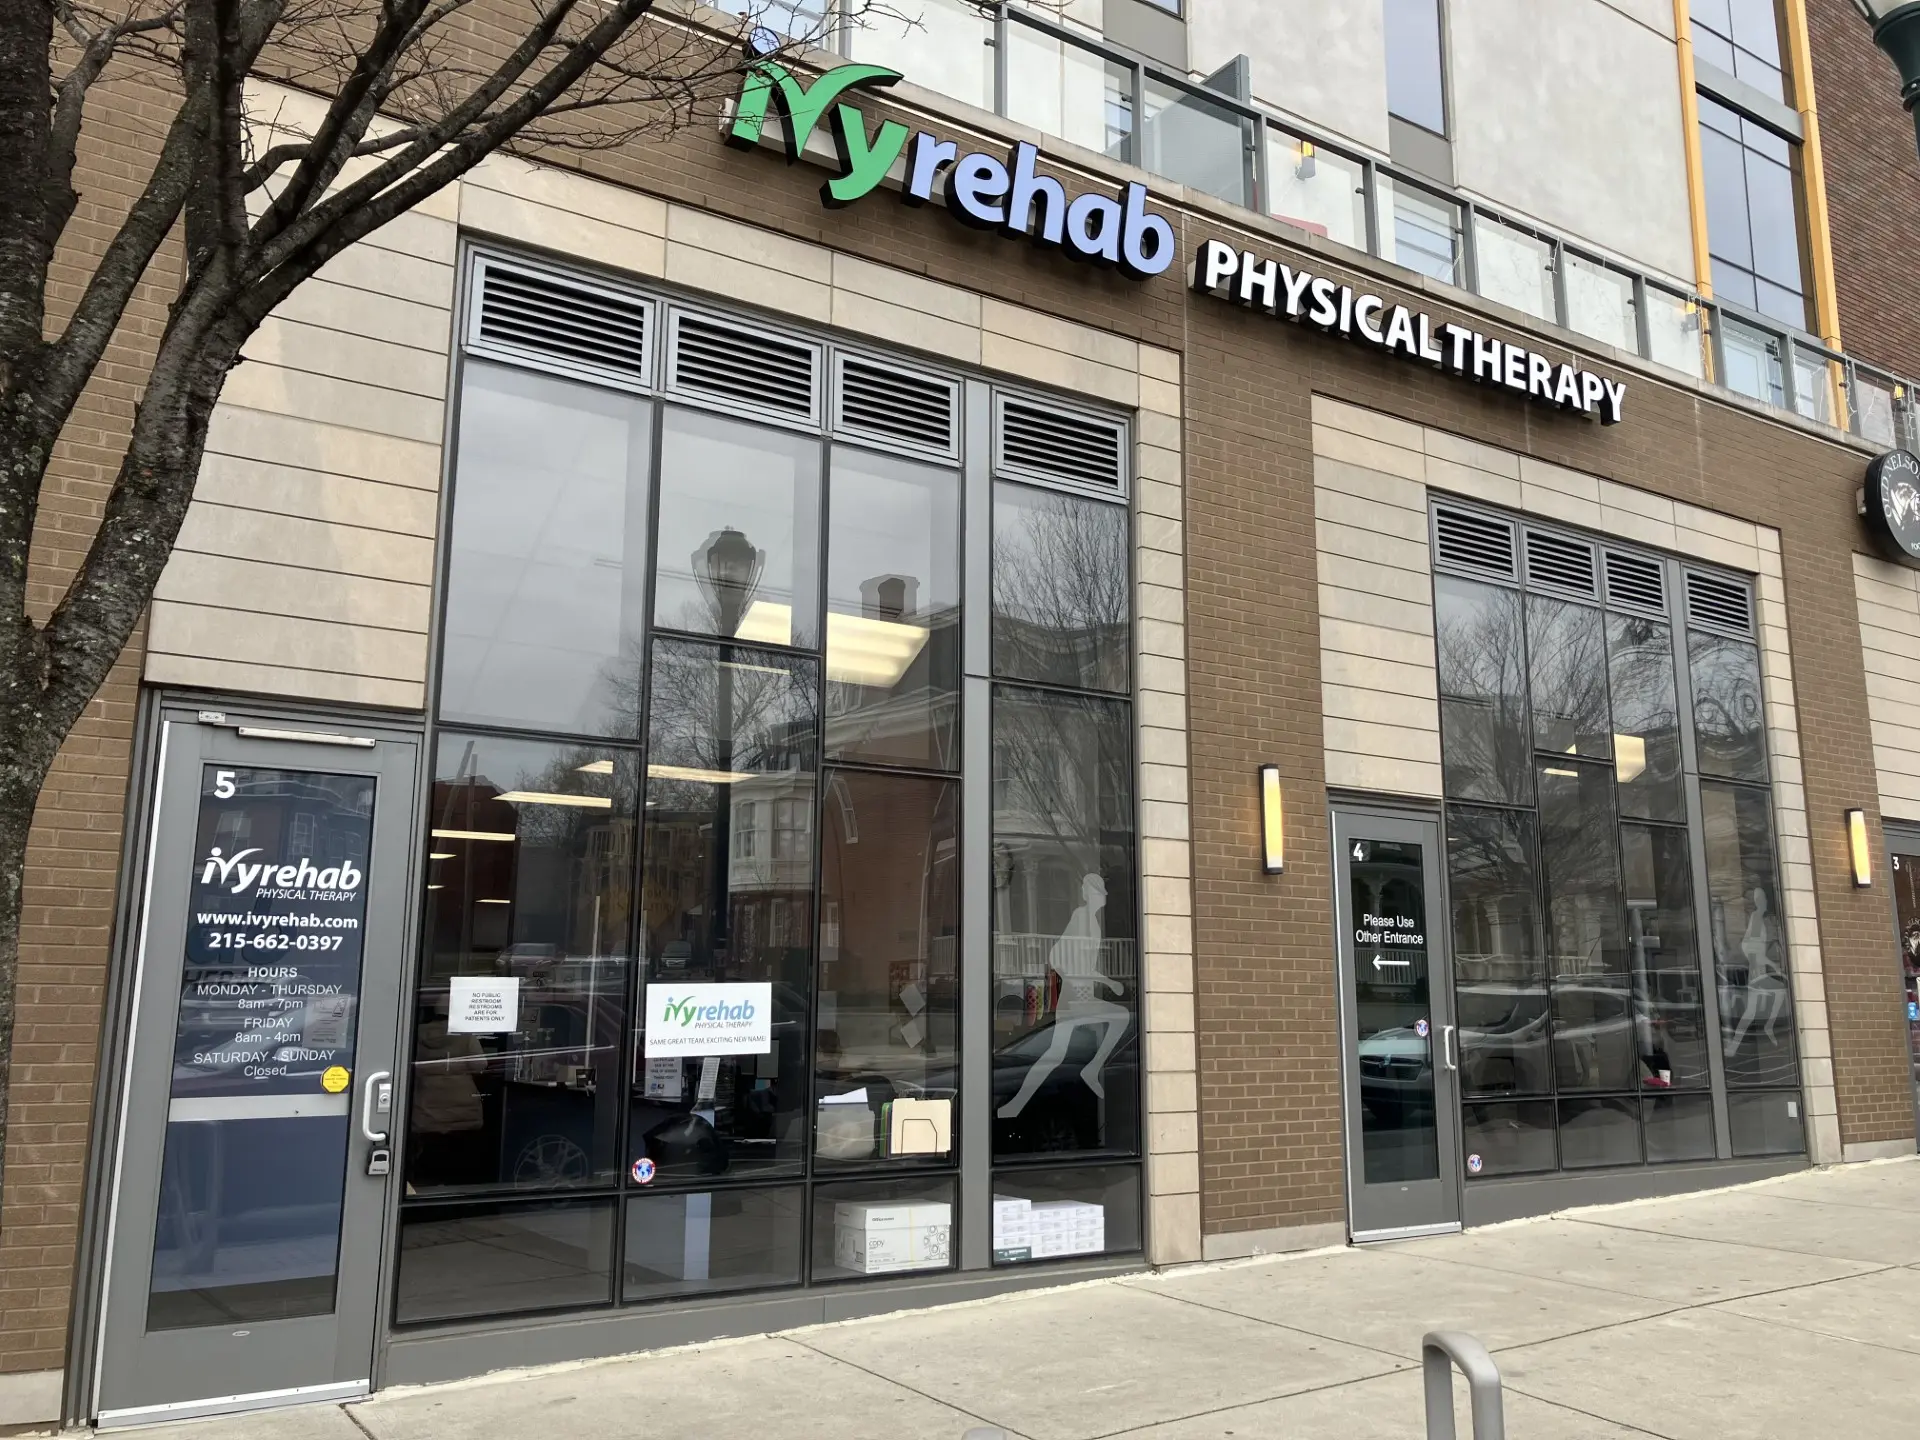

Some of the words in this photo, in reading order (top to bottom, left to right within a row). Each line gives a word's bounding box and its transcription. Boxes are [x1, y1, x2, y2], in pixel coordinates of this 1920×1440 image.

[726, 27, 1176, 277] ivyrehab
[1202, 240, 1442, 353] PHYSICAL
[1445, 323, 1627, 423] THERAPY
[213, 770, 236, 799] 5
[1353, 842, 1364, 861] 4
[201, 847, 362, 894] ivyrehab
[1892, 856, 1900, 870] 3
[255, 888, 307, 900] PHYSICAL
[310, 890, 356, 902] THERAPY
[197, 911, 358, 929] www.ivyrehab.com
[1363, 913, 1394, 927] Please
[1396, 915, 1414, 928] Use
[208, 932, 344, 951] 215-662-0397
[1355, 929, 1382, 943] Other
[1384, 931, 1424, 945] Entrance
[248, 967, 298, 978] HOURS
[197, 984, 259, 996] MONDAY
[270, 984, 342, 995] THURSDAY
[238, 999, 265, 1009] 8am
[277, 998, 304, 1010] 7pm
[663, 996, 755, 1028] ivyrehab
[243, 1017, 294, 1029] FRIDAY
[694, 1021, 724, 1029] PHYSICAL
[235, 1032, 262, 1043] 8am
[274, 1032, 301, 1044] 4pm
[667, 1037, 687, 1045] GREAT
[706, 1036, 734, 1044] EXCITING
[193, 1051, 269, 1064] SATURDAY
[280, 1049, 336, 1061] SUNDAY
[243, 1065, 287, 1077] Closed
